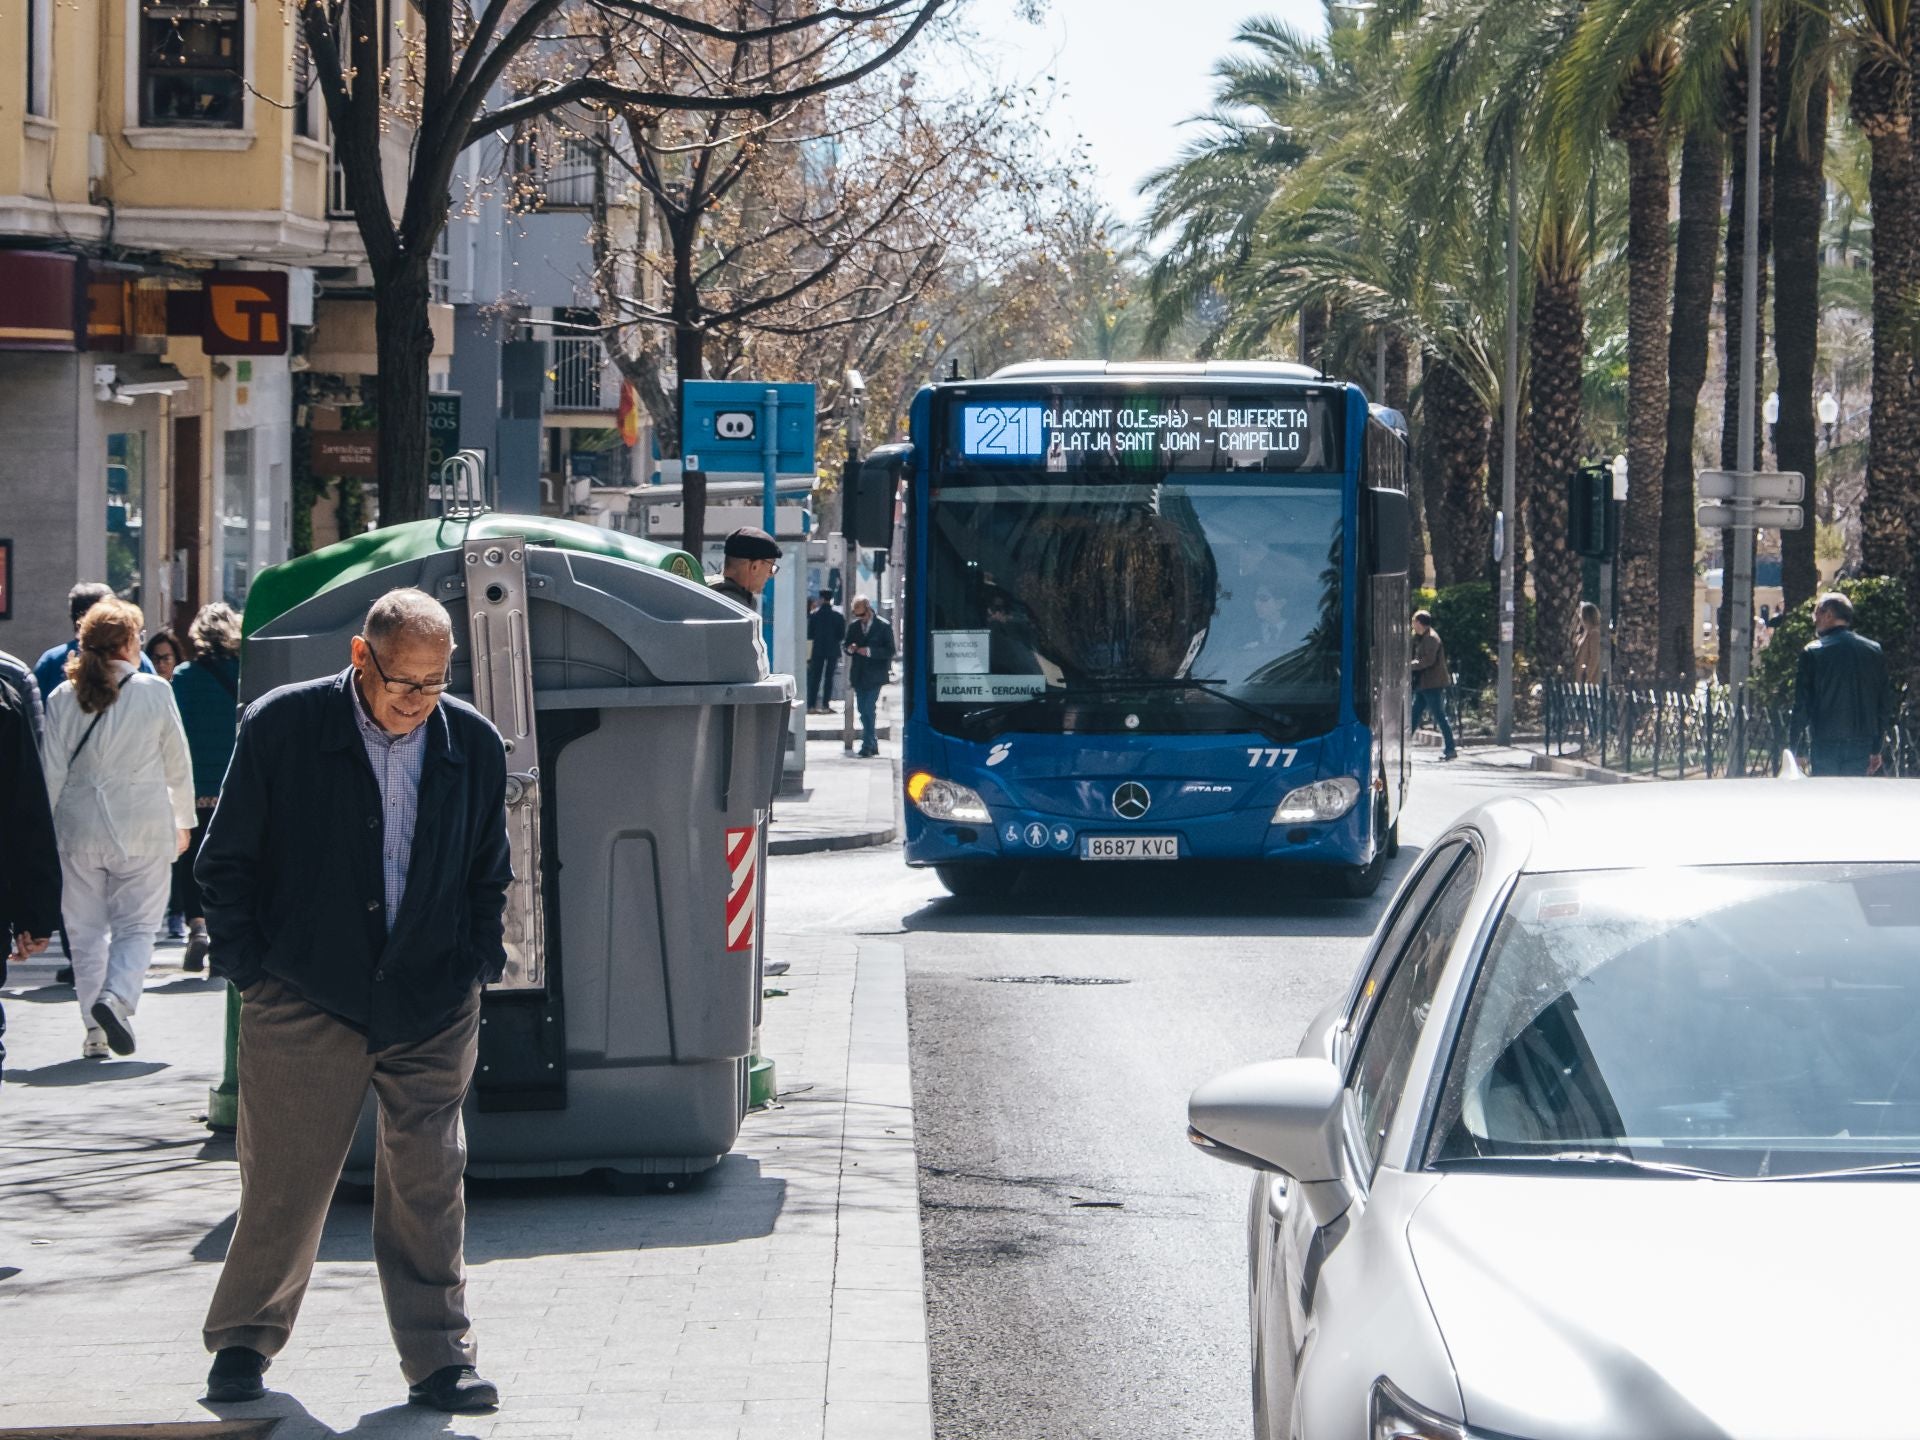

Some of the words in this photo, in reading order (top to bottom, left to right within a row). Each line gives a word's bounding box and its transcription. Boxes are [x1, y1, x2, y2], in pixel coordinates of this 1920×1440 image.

[1043, 409, 1112, 428] ALACANT
[1116, 409, 1189, 428] (O.Esplà)
[1208, 409, 1308, 428] ALBUFERETA
[976, 407, 1028, 455] 21
[1051, 432, 1111, 450] PLATJA
[1115, 432, 1155, 450] SANT
[1160, 432, 1200, 450] JOAN
[1219, 432, 1300, 450] CAMPELLO
[941, 686, 983, 696] ALICANTE
[991, 684, 1041, 696] CERCANÍAS
[1247, 748, 1298, 768] 777
[1092, 840, 1136, 855] 8687
[1142, 839, 1174, 855] KVC
